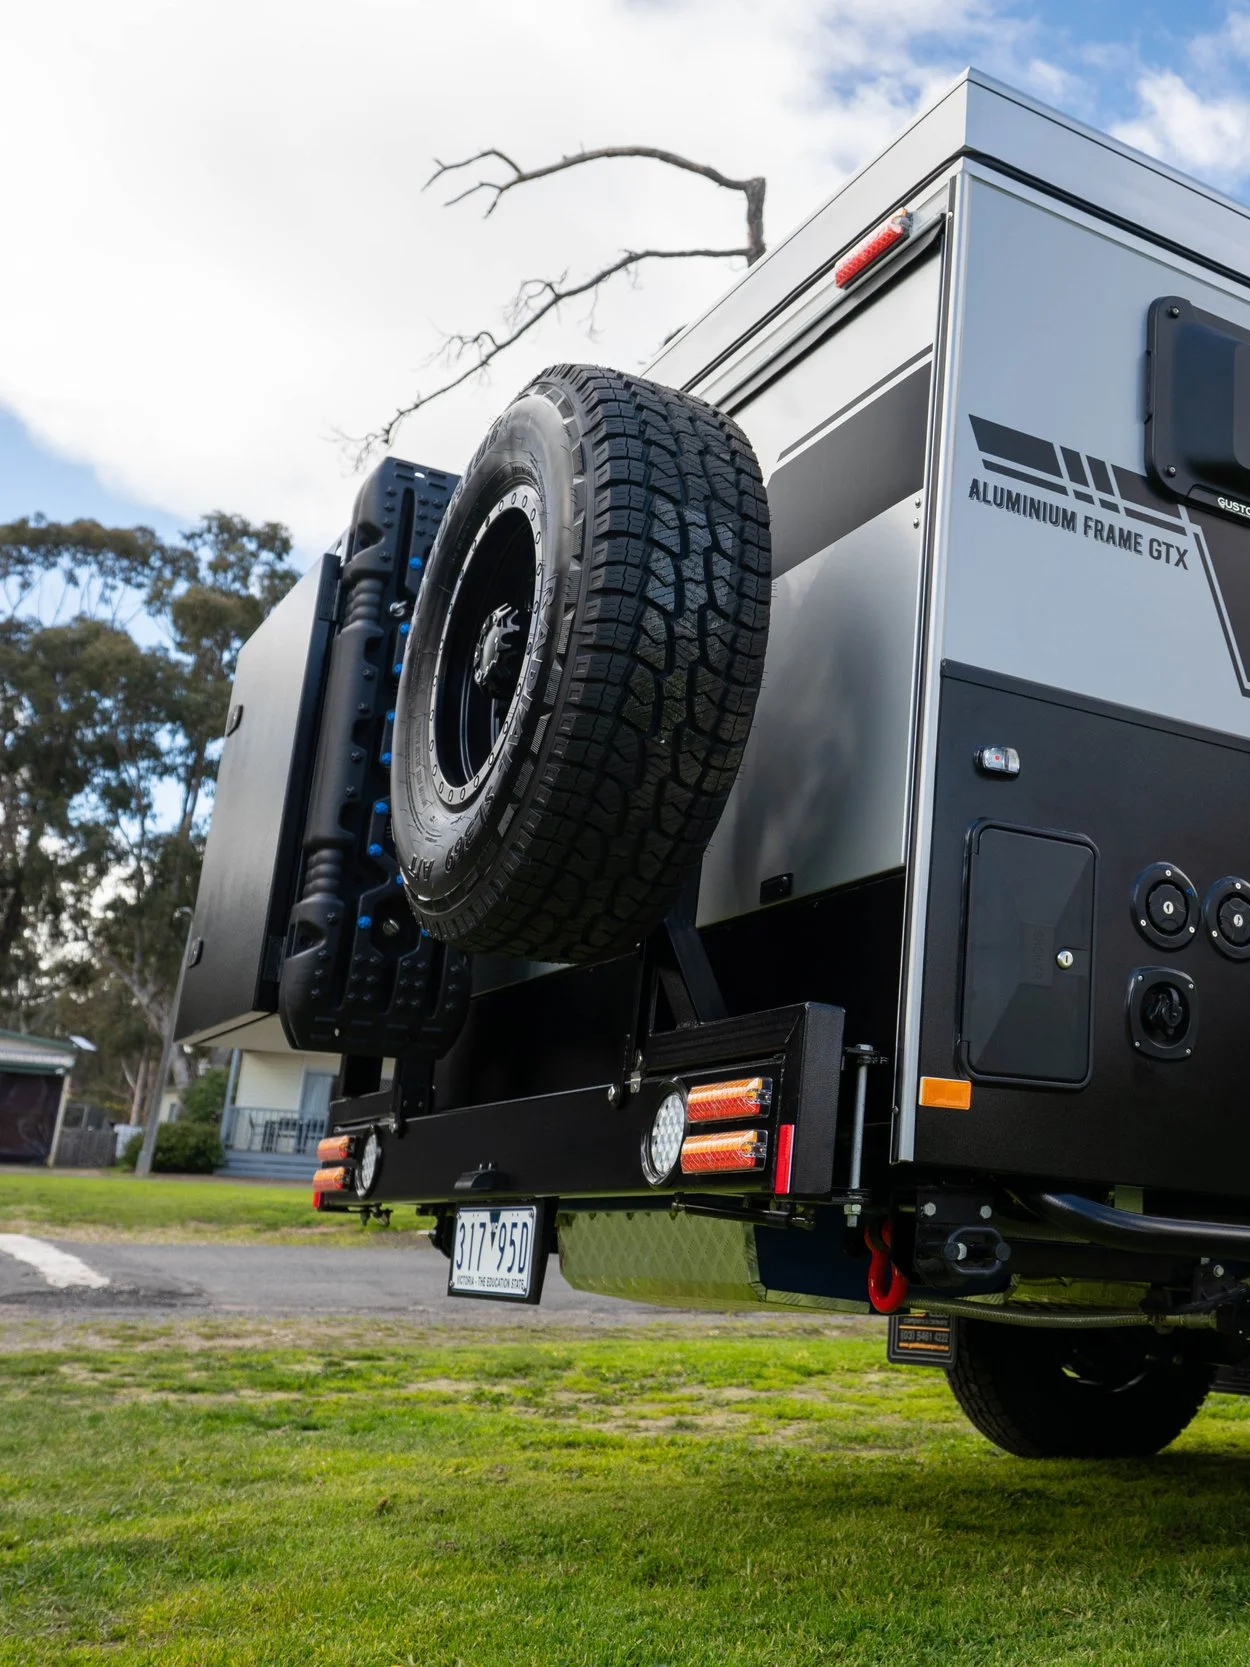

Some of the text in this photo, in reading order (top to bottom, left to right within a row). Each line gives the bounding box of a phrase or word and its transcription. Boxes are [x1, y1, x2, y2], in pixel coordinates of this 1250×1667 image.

[968, 478, 1189, 571] ALUMINIUM FRAME GTX
[456, 1222, 529, 1274] 317 95D
